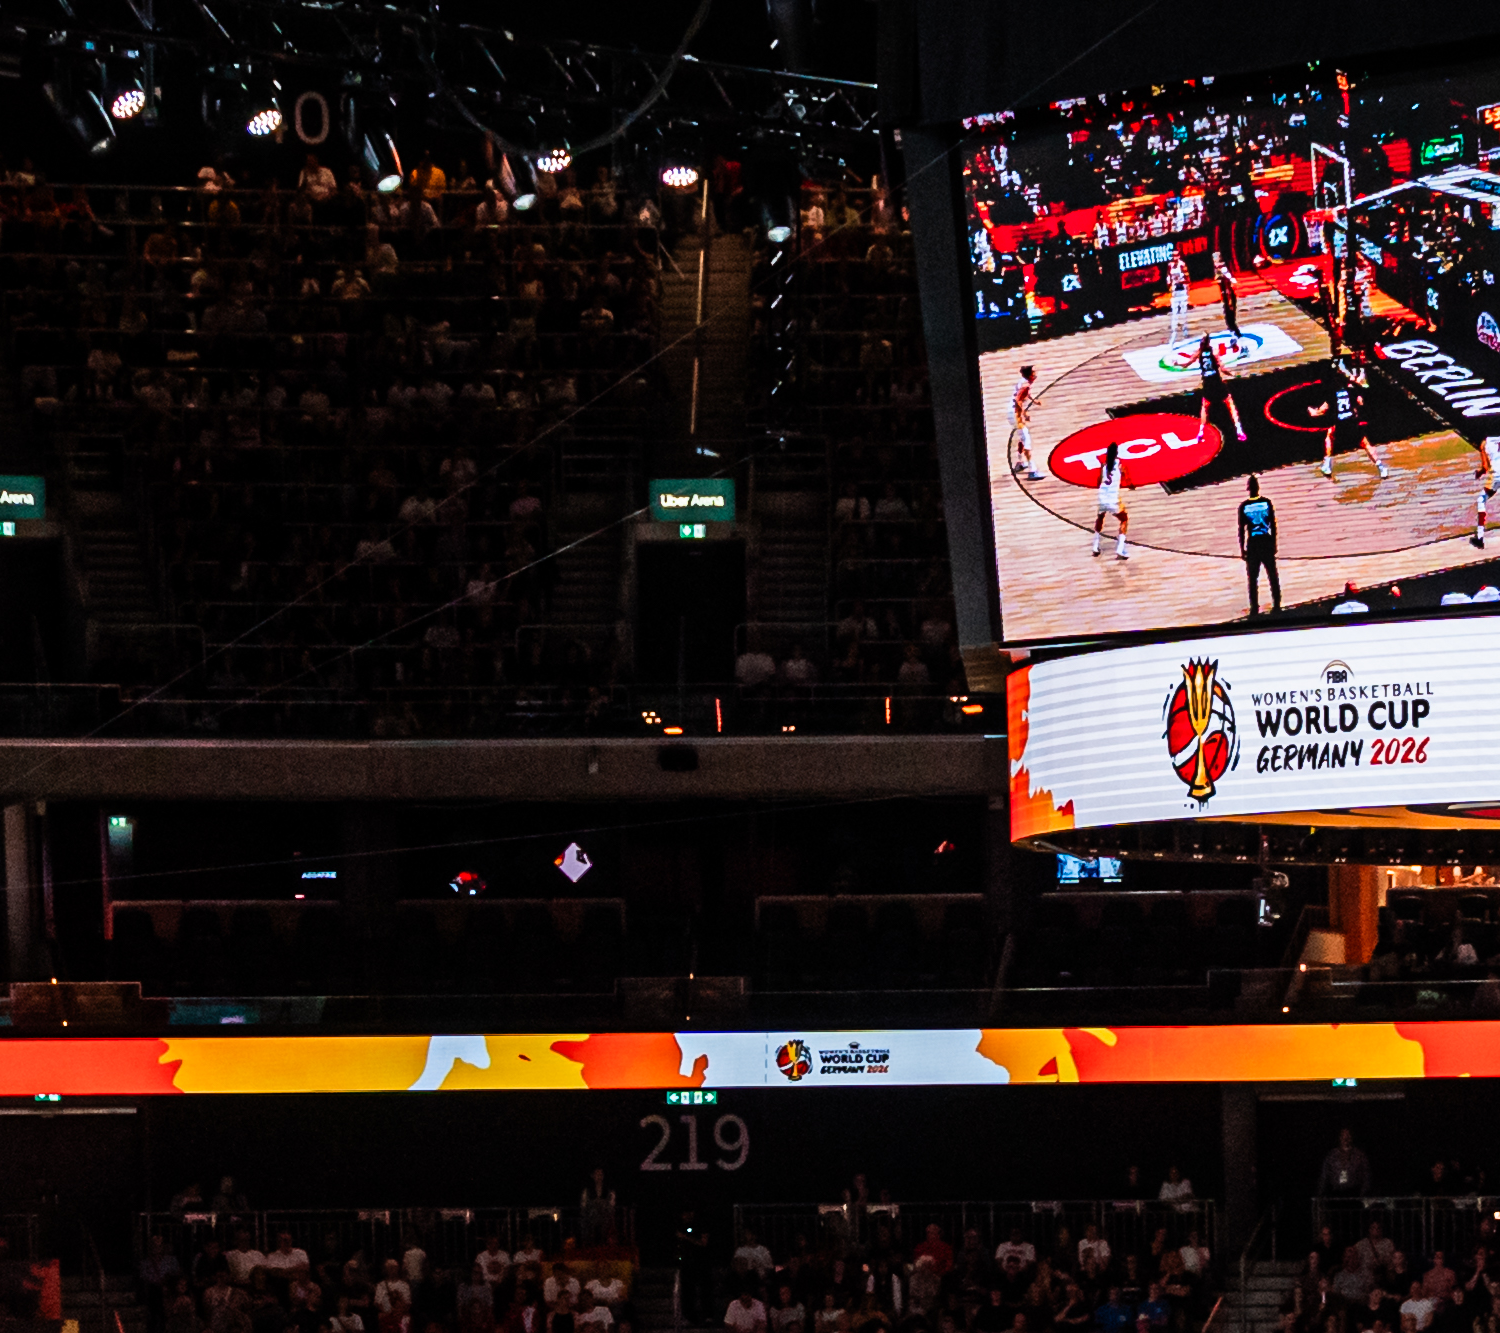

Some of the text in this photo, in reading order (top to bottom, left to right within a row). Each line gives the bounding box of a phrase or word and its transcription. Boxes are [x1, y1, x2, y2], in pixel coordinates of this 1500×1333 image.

[1064, 432, 1205, 470] TCL
[0, 491, 34, 506] Arena
[660, 493, 725, 508] Uber Arena
[1252, 681, 1434, 707] WOMEN'S BASKETBALL
[1255, 699, 1430, 738] WORLD CUP
[1257, 736, 1430, 774] GERMANY 2026
[820, 1053, 889, 1064] WORLD CUP
[640, 1114, 749, 1170] 219
